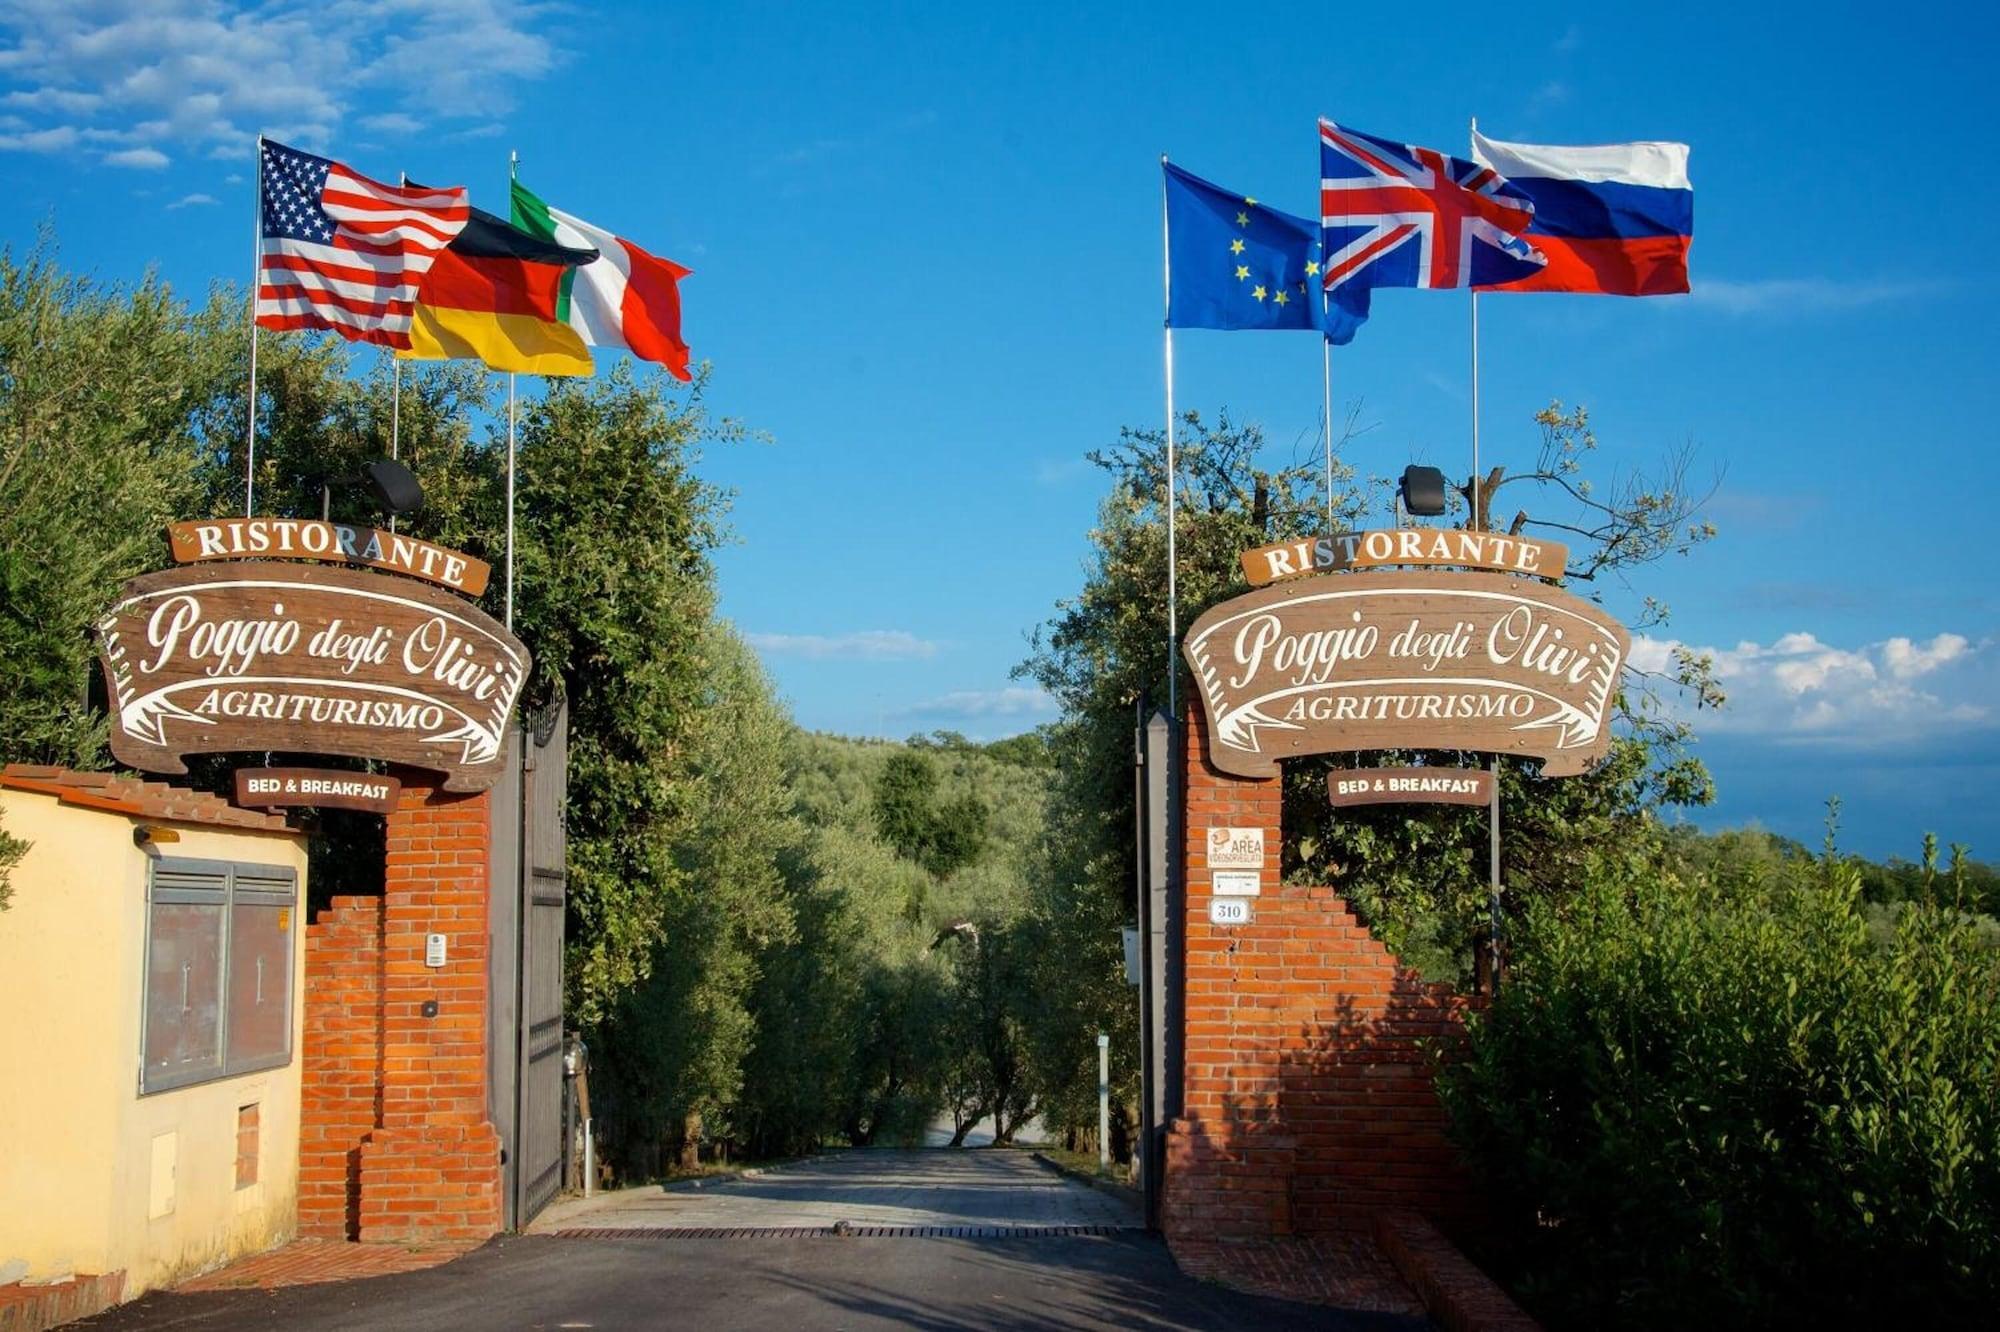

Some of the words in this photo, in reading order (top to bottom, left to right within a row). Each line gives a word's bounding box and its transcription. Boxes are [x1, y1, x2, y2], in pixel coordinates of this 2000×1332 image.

[195, 522, 466, 587] RISTORANTE
[1265, 531, 1541, 579] RISTORANTE
[140, 596, 299, 677] Poggio
[309, 620, 392, 675] degli
[403, 617, 504, 700] Olivi
[1230, 611, 1378, 688] Poggio
[1389, 619, 1474, 672] degli
[1487, 605, 1598, 684] Olivi
[195, 689, 444, 730] AGRITURISMO
[1284, 694, 1535, 721] AGRITURISMO
[248, 778, 281, 793] BED
[285, 779, 297, 793] &
[300, 779, 389, 799] BREAKFAST
[1338, 779, 1369, 795] BED
[1373, 779, 1385, 792] &
[1389, 778, 1480, 793] BREAKFAST
[1231, 840, 1262, 853] AREA
[1218, 905, 1241, 918] 310
